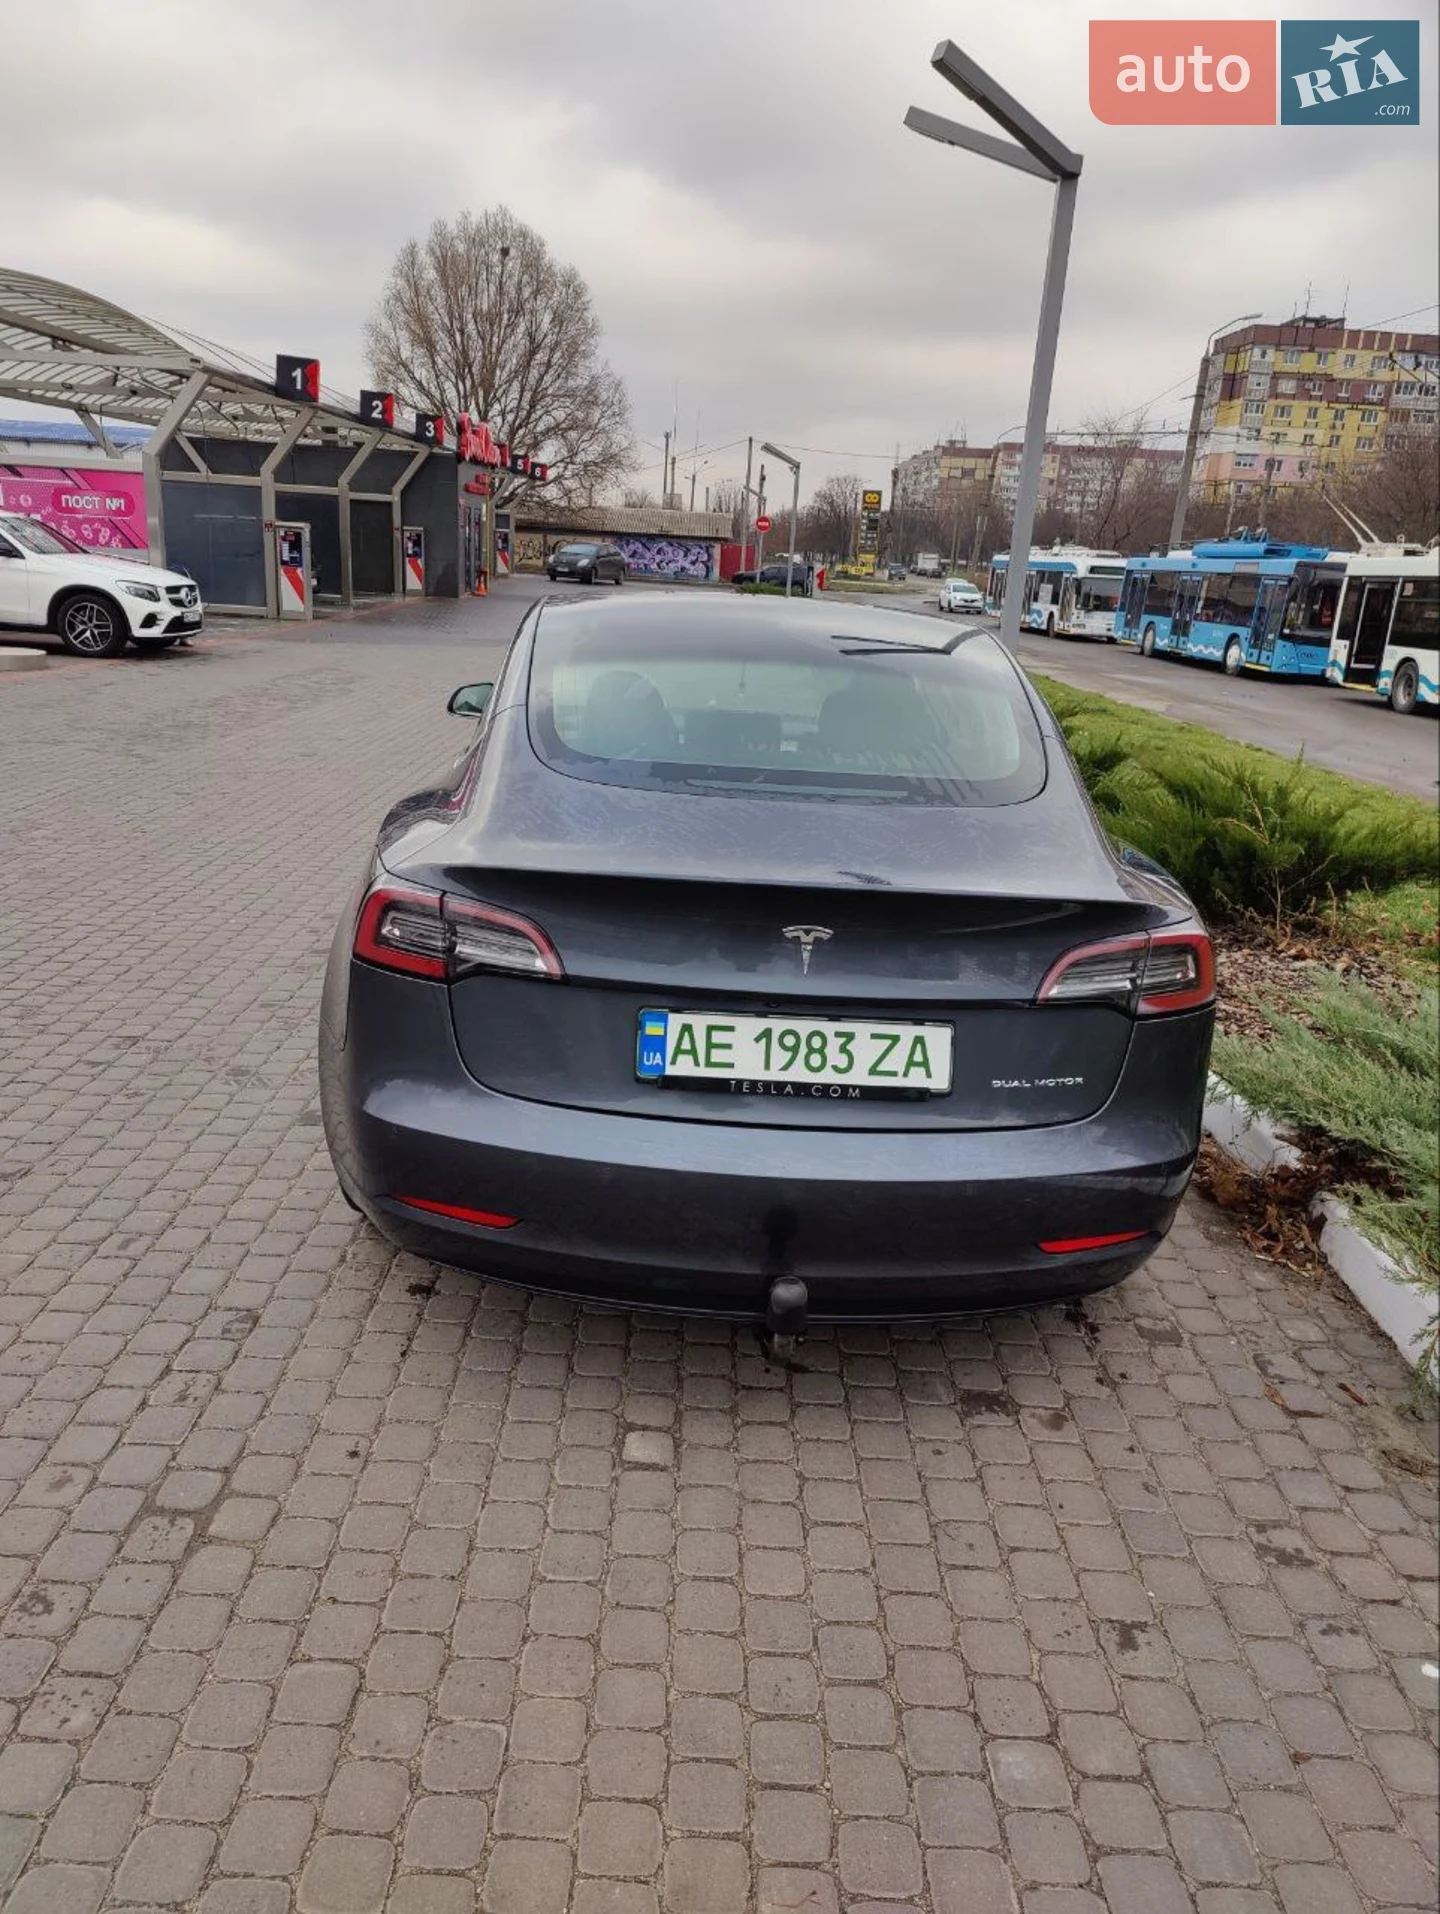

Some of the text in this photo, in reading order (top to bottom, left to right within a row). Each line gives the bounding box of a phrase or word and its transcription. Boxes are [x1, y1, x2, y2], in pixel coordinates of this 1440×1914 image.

[291, 368, 303, 390] 1
[371, 401, 383, 419] 2
[425, 422, 435, 437] 3
[61, 494, 125, 511] ПОСТ №1
[643, 1052, 663, 1066] UA
[670, 1023, 932, 1079] AE 1983 ZA
[992, 1077, 1084, 1088] DUAL MOTOR
